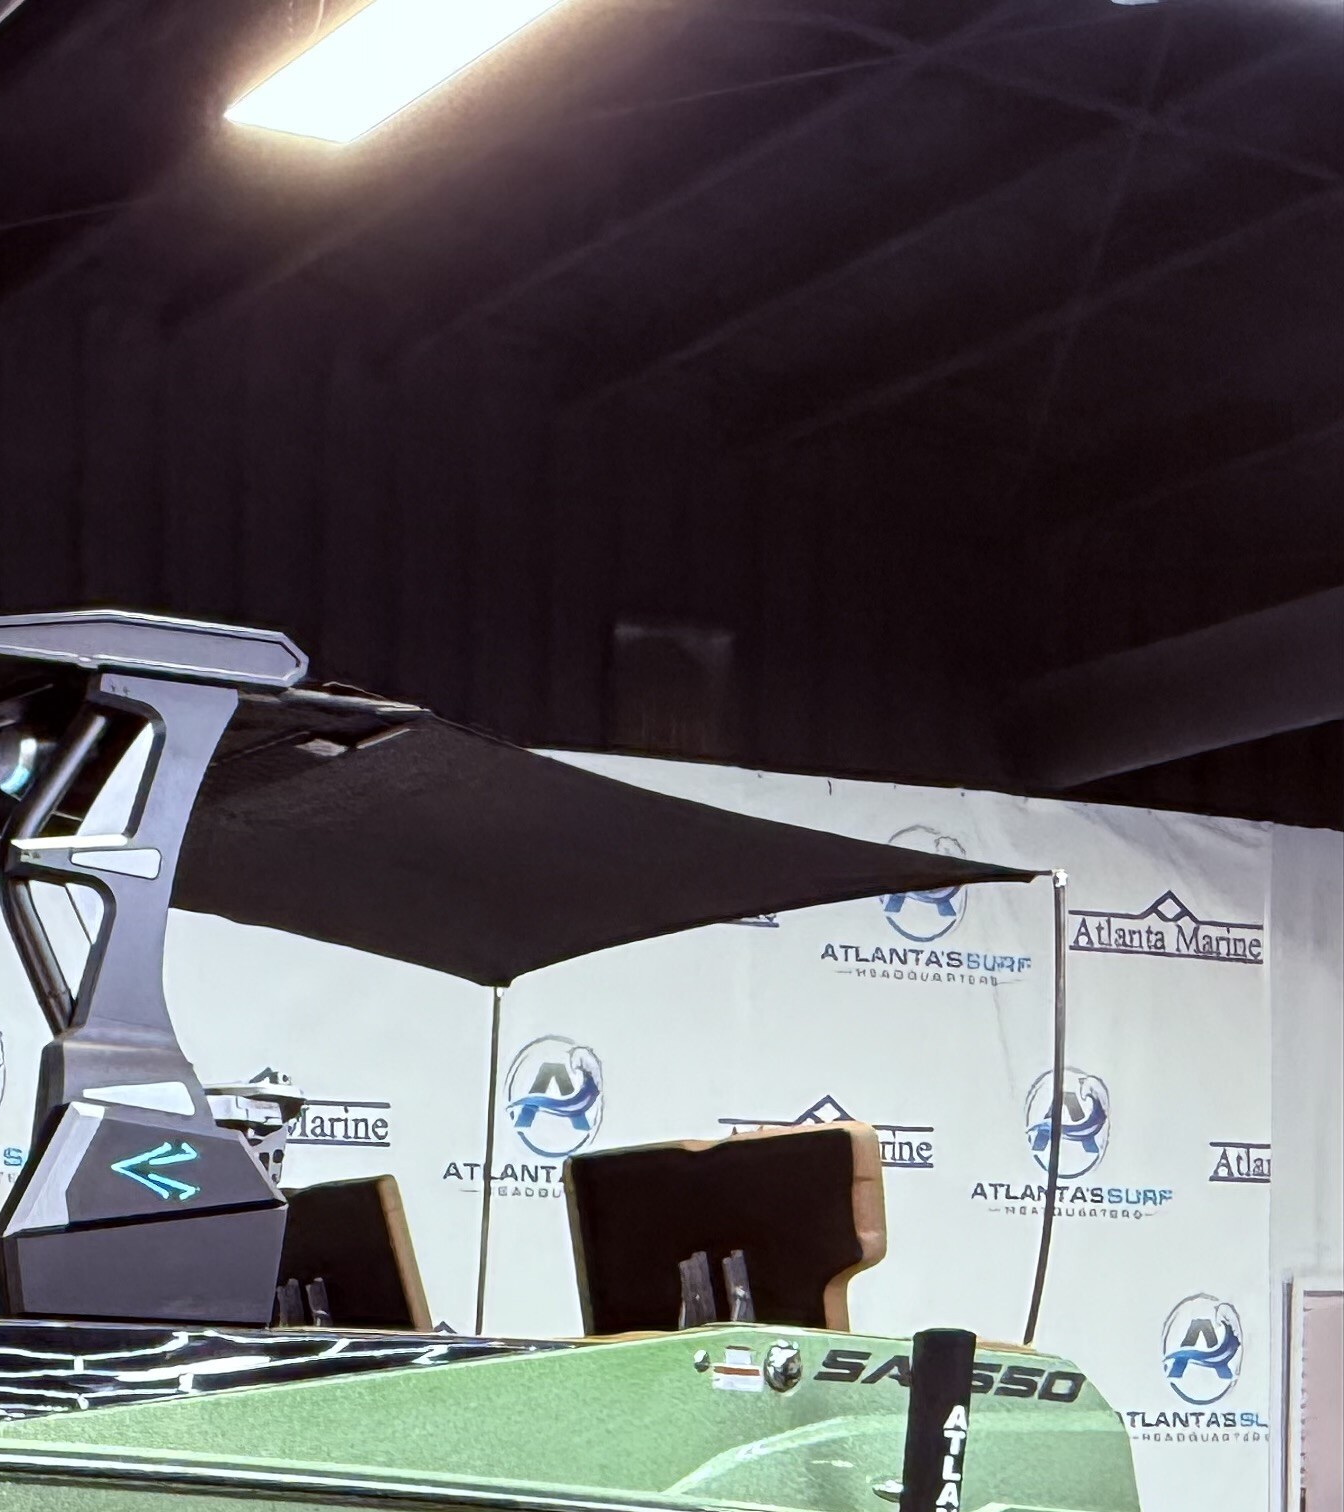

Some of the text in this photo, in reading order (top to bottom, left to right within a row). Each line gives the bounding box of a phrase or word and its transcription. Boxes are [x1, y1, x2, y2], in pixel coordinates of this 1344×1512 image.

[1073, 917, 1262, 960] Atlanta Marine
[880, 1131, 933, 1163] rine
